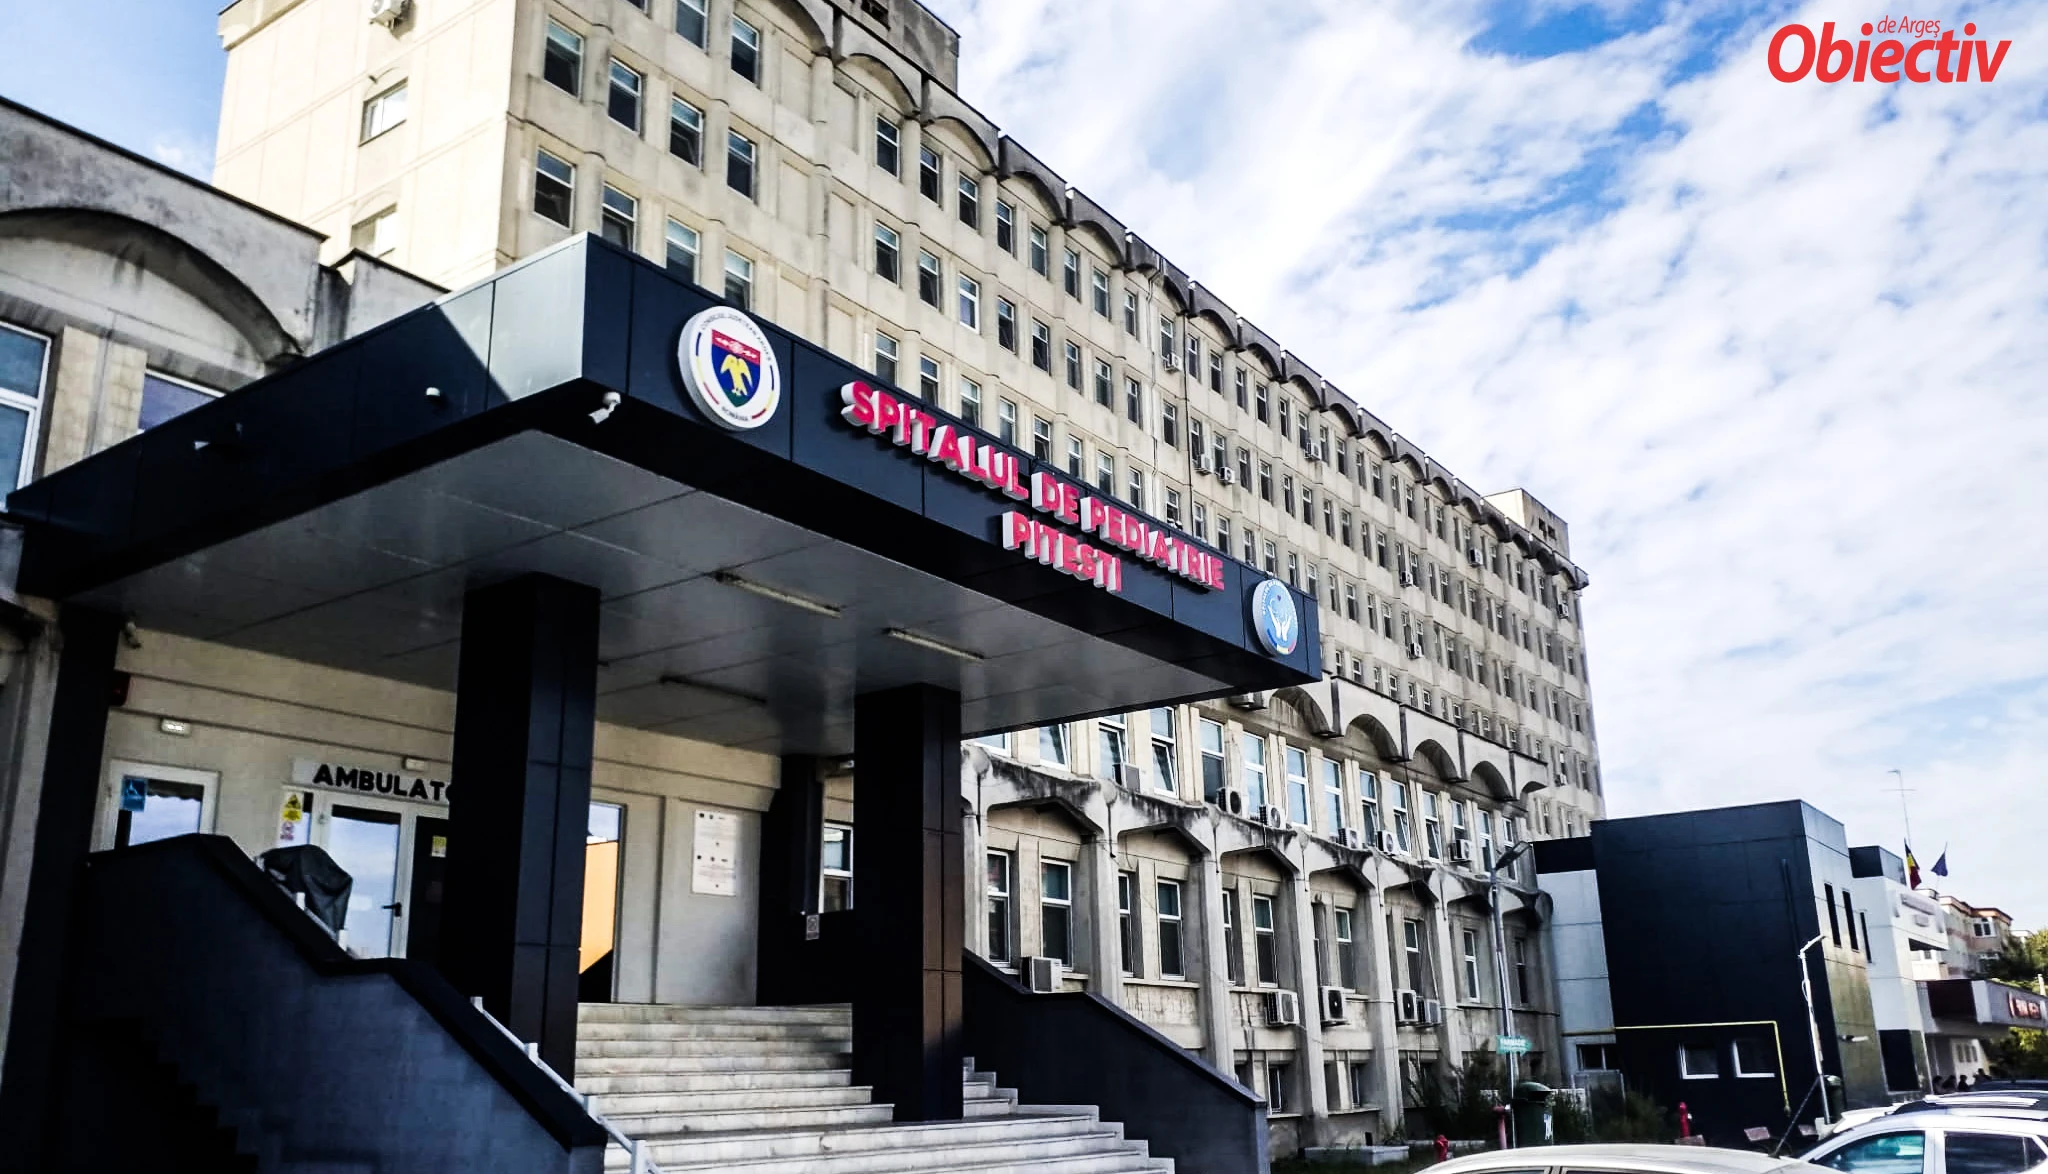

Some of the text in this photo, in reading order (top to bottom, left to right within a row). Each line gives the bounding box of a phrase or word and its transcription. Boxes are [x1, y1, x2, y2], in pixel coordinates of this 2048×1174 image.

[841, 380, 1225, 591] SPITALUL DE PEDIATRIE
[313, 763, 450, 801] AMBULAT
